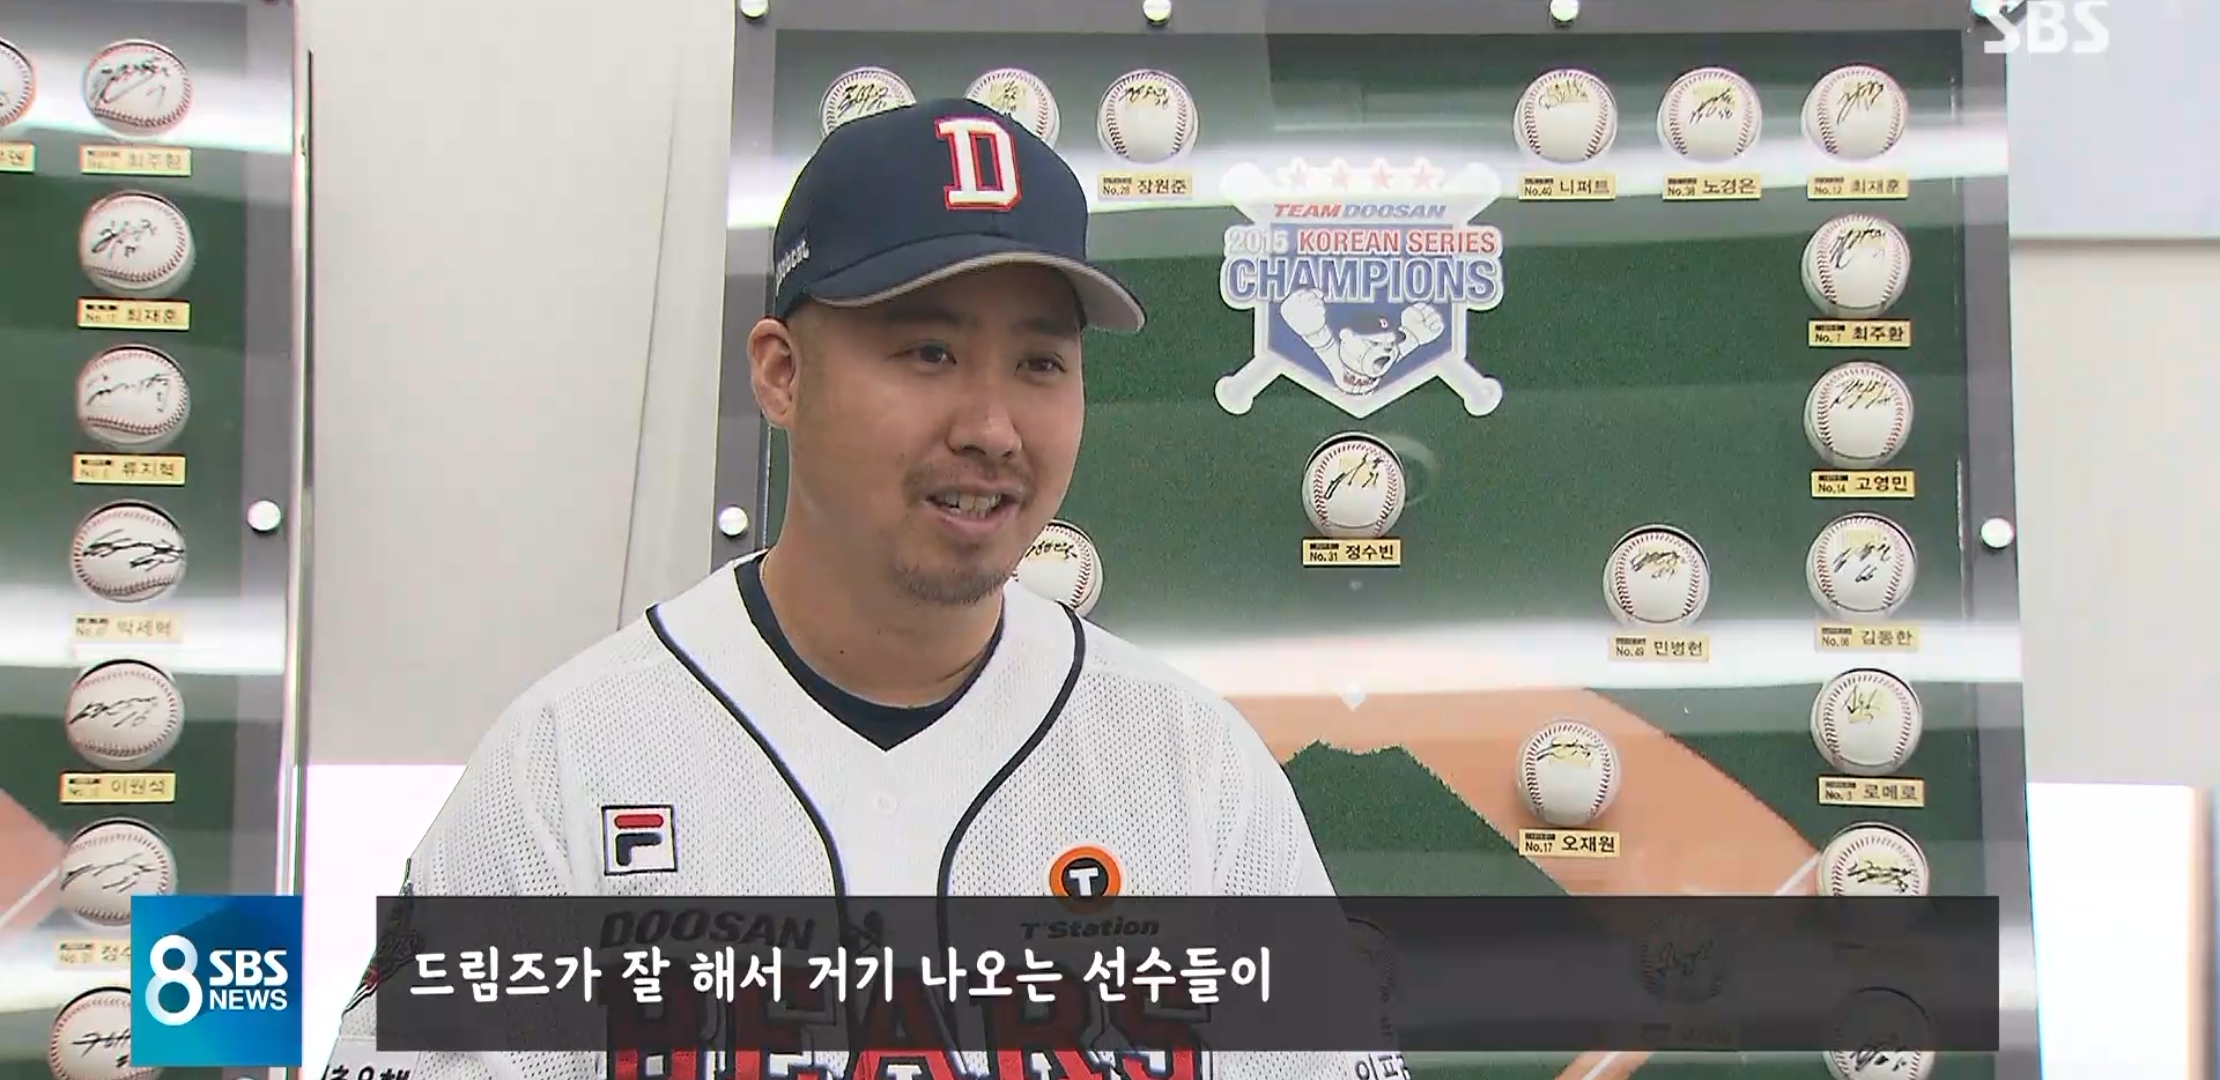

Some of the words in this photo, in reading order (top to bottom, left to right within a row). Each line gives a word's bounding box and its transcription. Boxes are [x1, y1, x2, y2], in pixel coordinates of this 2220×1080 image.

[934, 116, 1021, 210] D
[1138, 178, 1187, 195] 장원준
[1560, 178, 1610, 194] 니퍼트
[1702, 177, 1756, 195] 노경은
[1273, 203, 1342, 218] TEAM
[1341, 203, 1447, 219] DOOSAN
[1226, 230, 1290, 253] 2015
[1299, 230, 1400, 253] KOREAN
[1407, 231, 1496, 254] SERIES
[1228, 257, 1497, 301] CHAMPIONS
[1853, 325, 1904, 342] 최주환
[1855, 475, 1908, 492] 고영민
[1309, 551, 1338, 562] No.31
[1345, 544, 1394, 561] 정수빈
[1860, 629, 1913, 647] 김동한
[1862, 784, 1917, 801] 로메로
[1525, 840, 1554, 853] No.17
[1561, 834, 1616, 853] 오재원
[601, 908, 815, 952] DOOSAN
